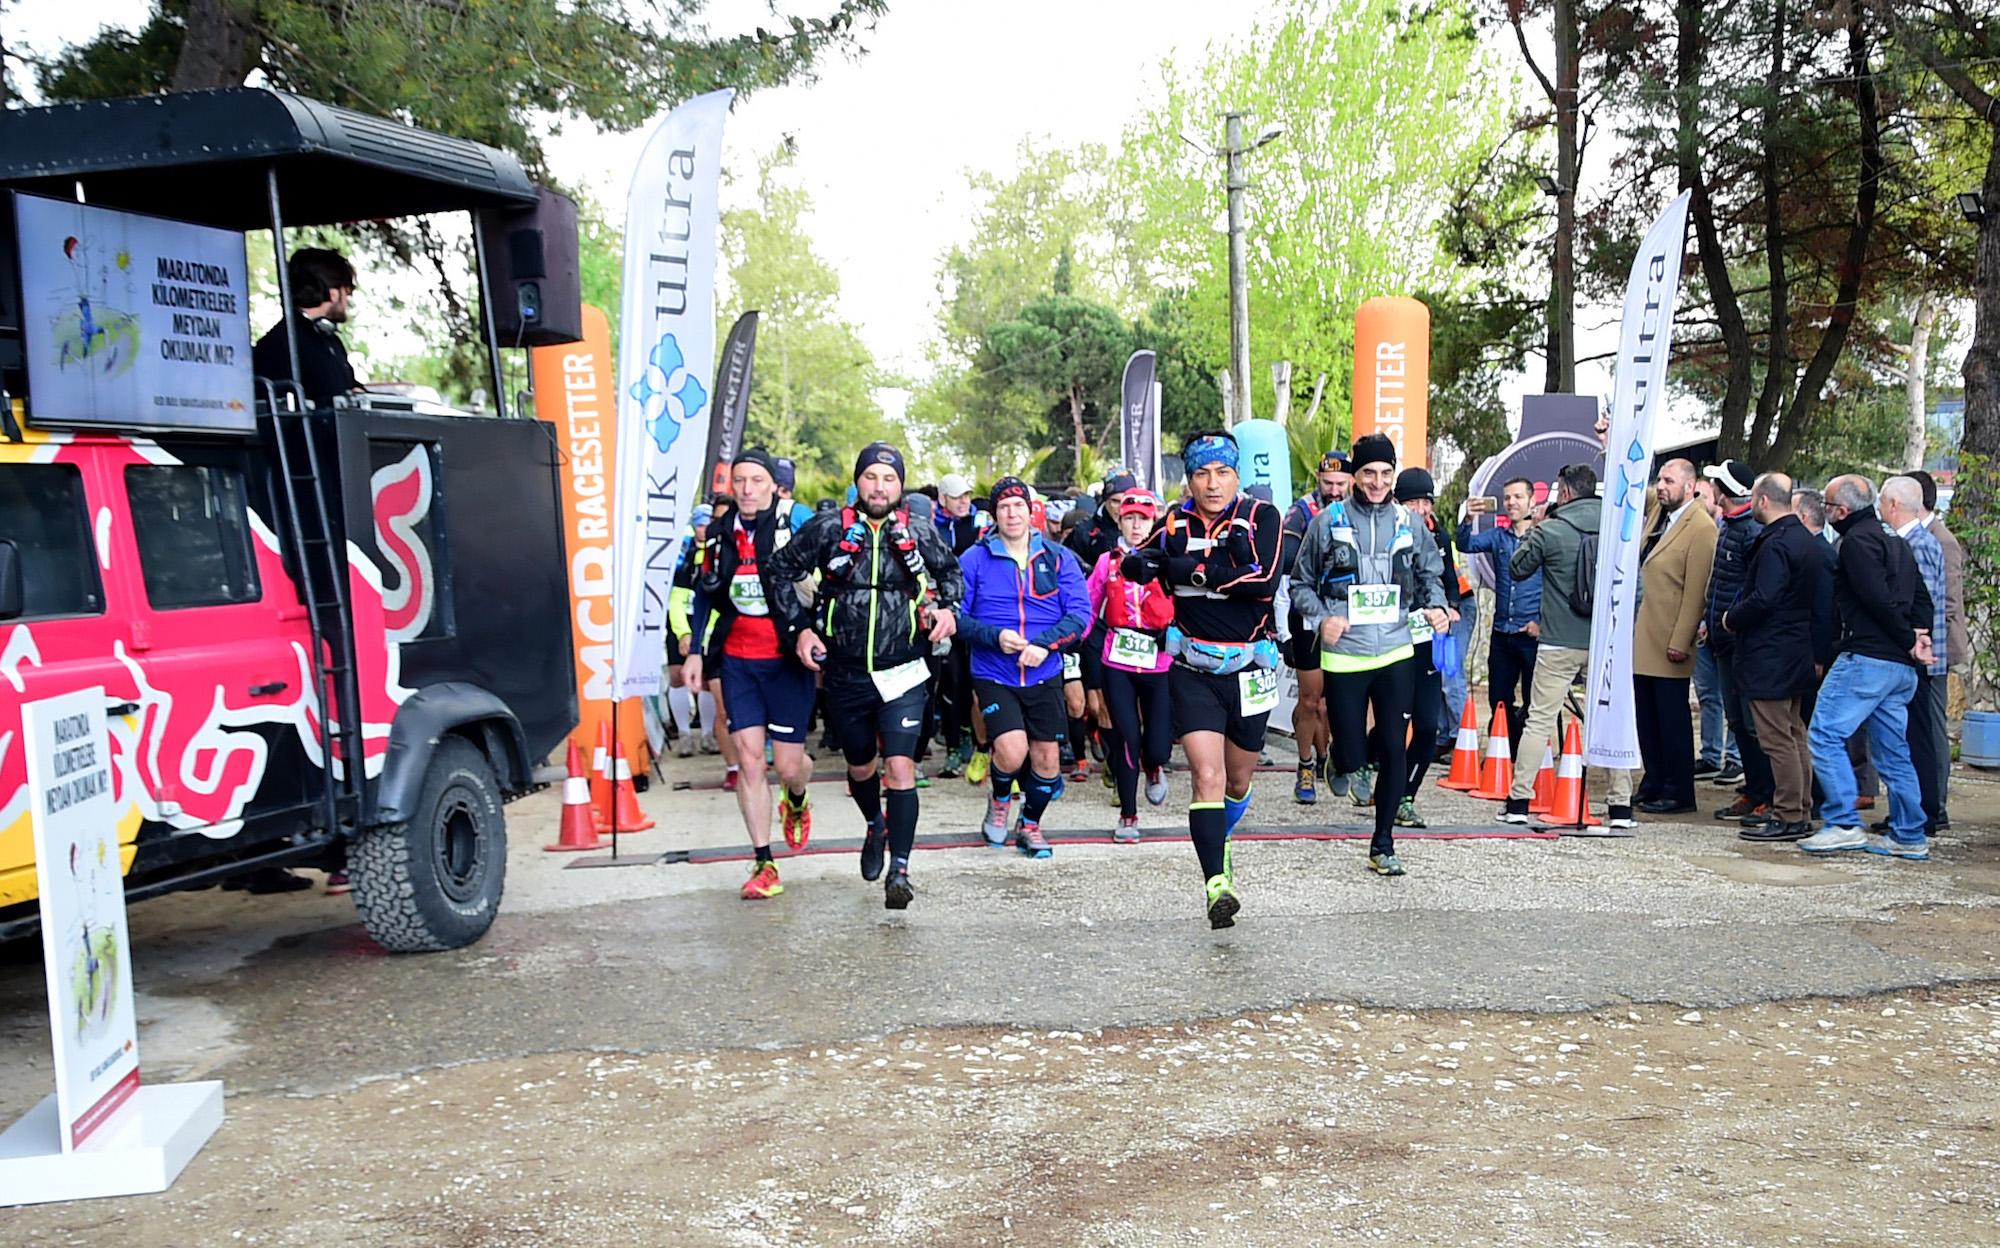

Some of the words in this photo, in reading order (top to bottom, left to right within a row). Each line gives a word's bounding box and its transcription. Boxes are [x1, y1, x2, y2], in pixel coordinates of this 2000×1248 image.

[650, 145, 696, 321] ultra
[157, 256, 230, 288] MARATONDA
[172, 313, 221, 339] MEYDAN
[160, 339, 212, 364] OKUMAK
[563, 354, 609, 540] RACESETTER
[1125, 636, 1150, 652] 314
